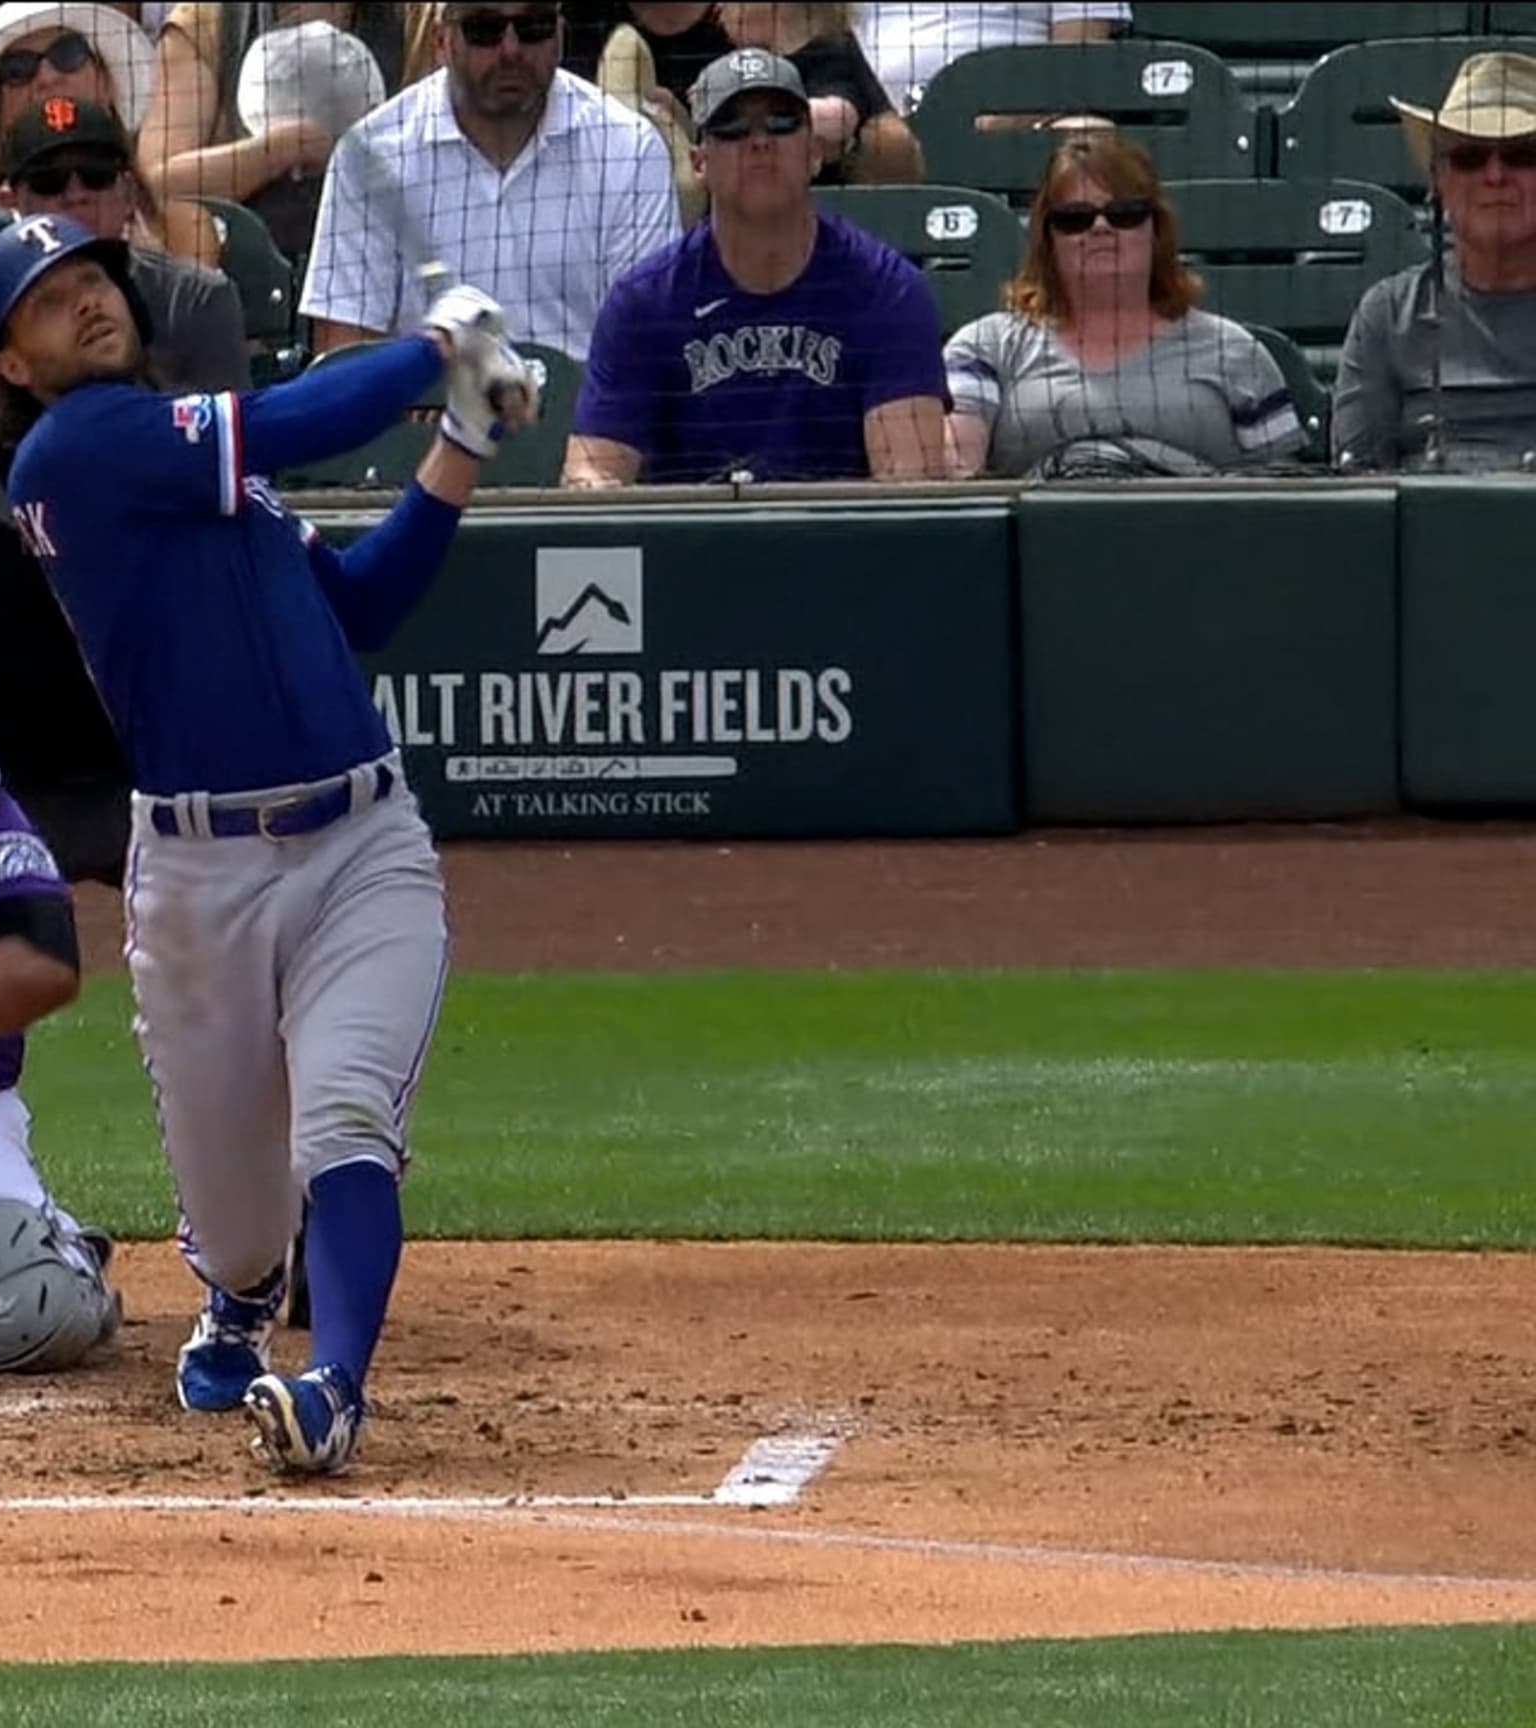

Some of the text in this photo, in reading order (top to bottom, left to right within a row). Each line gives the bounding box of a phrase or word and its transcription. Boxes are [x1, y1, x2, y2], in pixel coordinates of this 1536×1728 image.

[1161, 66, 1176, 88] 7
[944, 210, 960, 232] 6
[1338, 205, 1353, 227] 7
[17, 216, 62, 252] T
[683, 325, 842, 393] ROCKIES
[372, 668, 852, 745] ALT RIVER FIELDS
[472, 792, 711, 816] AT TALKING STICK
